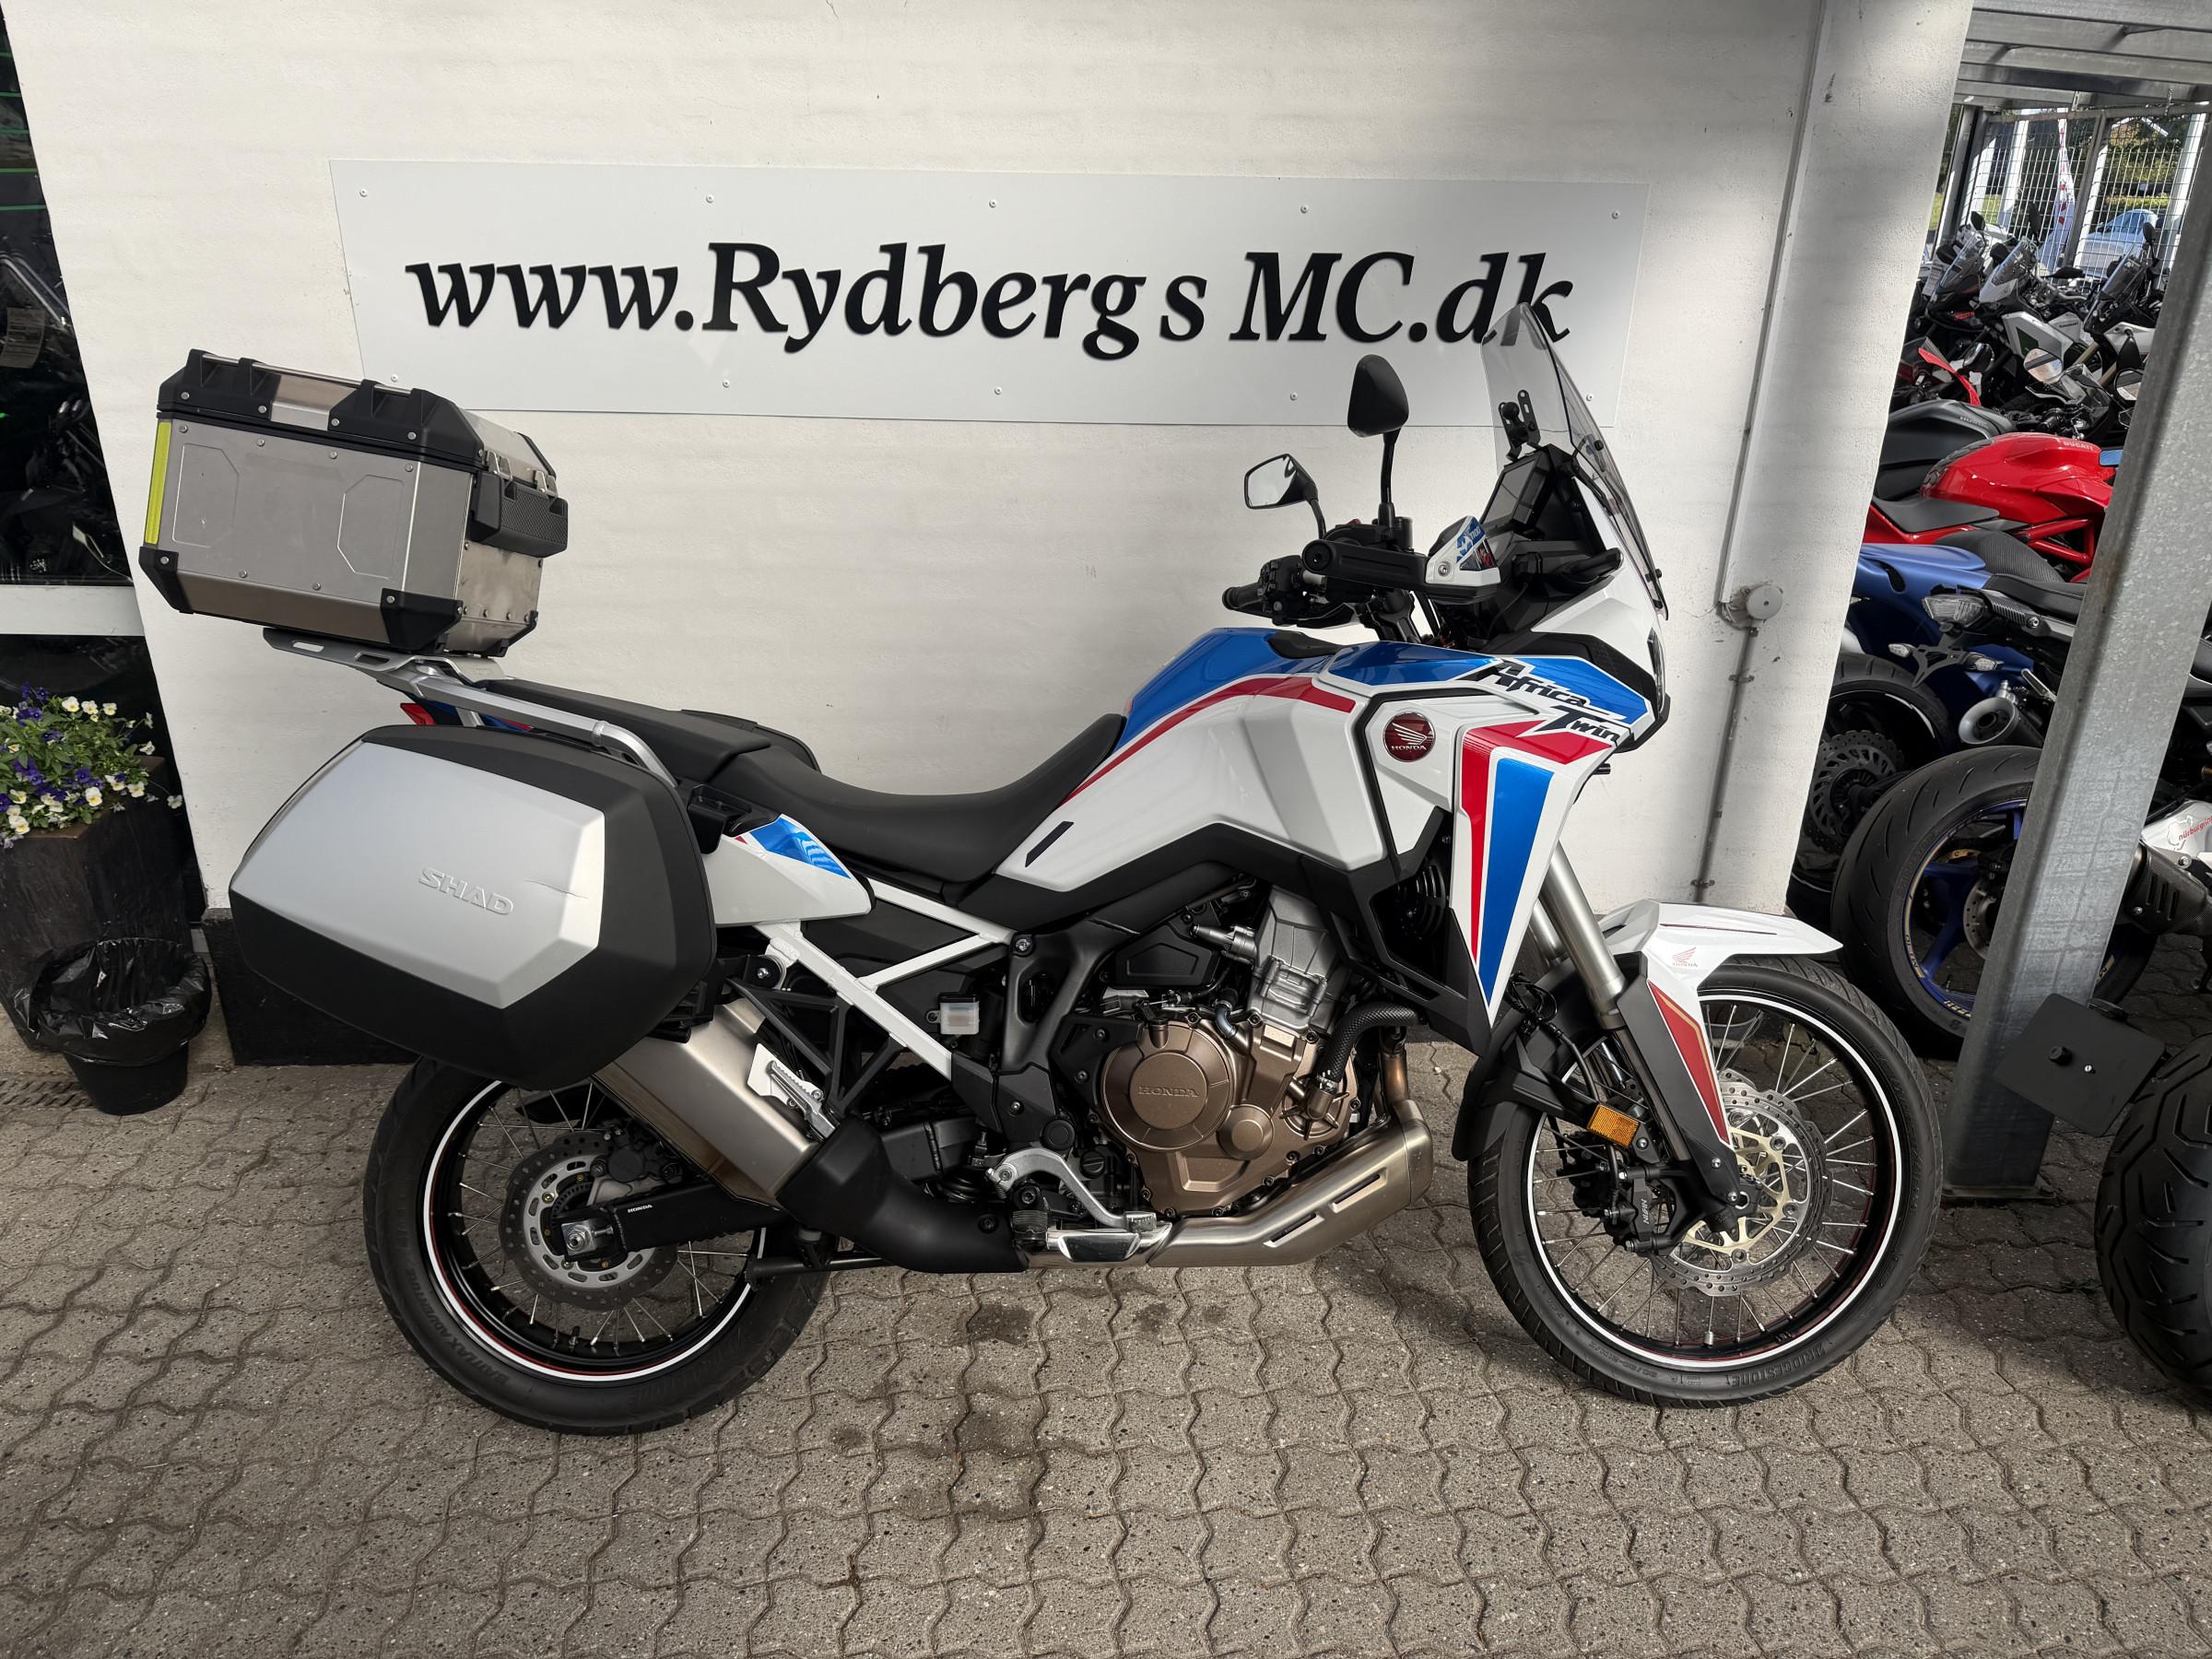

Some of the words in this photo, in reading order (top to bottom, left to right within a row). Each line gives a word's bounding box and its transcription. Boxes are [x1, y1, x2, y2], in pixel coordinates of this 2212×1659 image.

[1229, 252, 1574, 347] MC.dk
[1455, 660, 1588, 707] Africa
[1534, 704, 1621, 743] Twin
[1391, 743, 1428, 751] HONDA
[418, 865, 514, 915] SHAD
[1137, 1085, 1199, 1098] HONDA
[627, 1204, 653, 1214] HONDA
